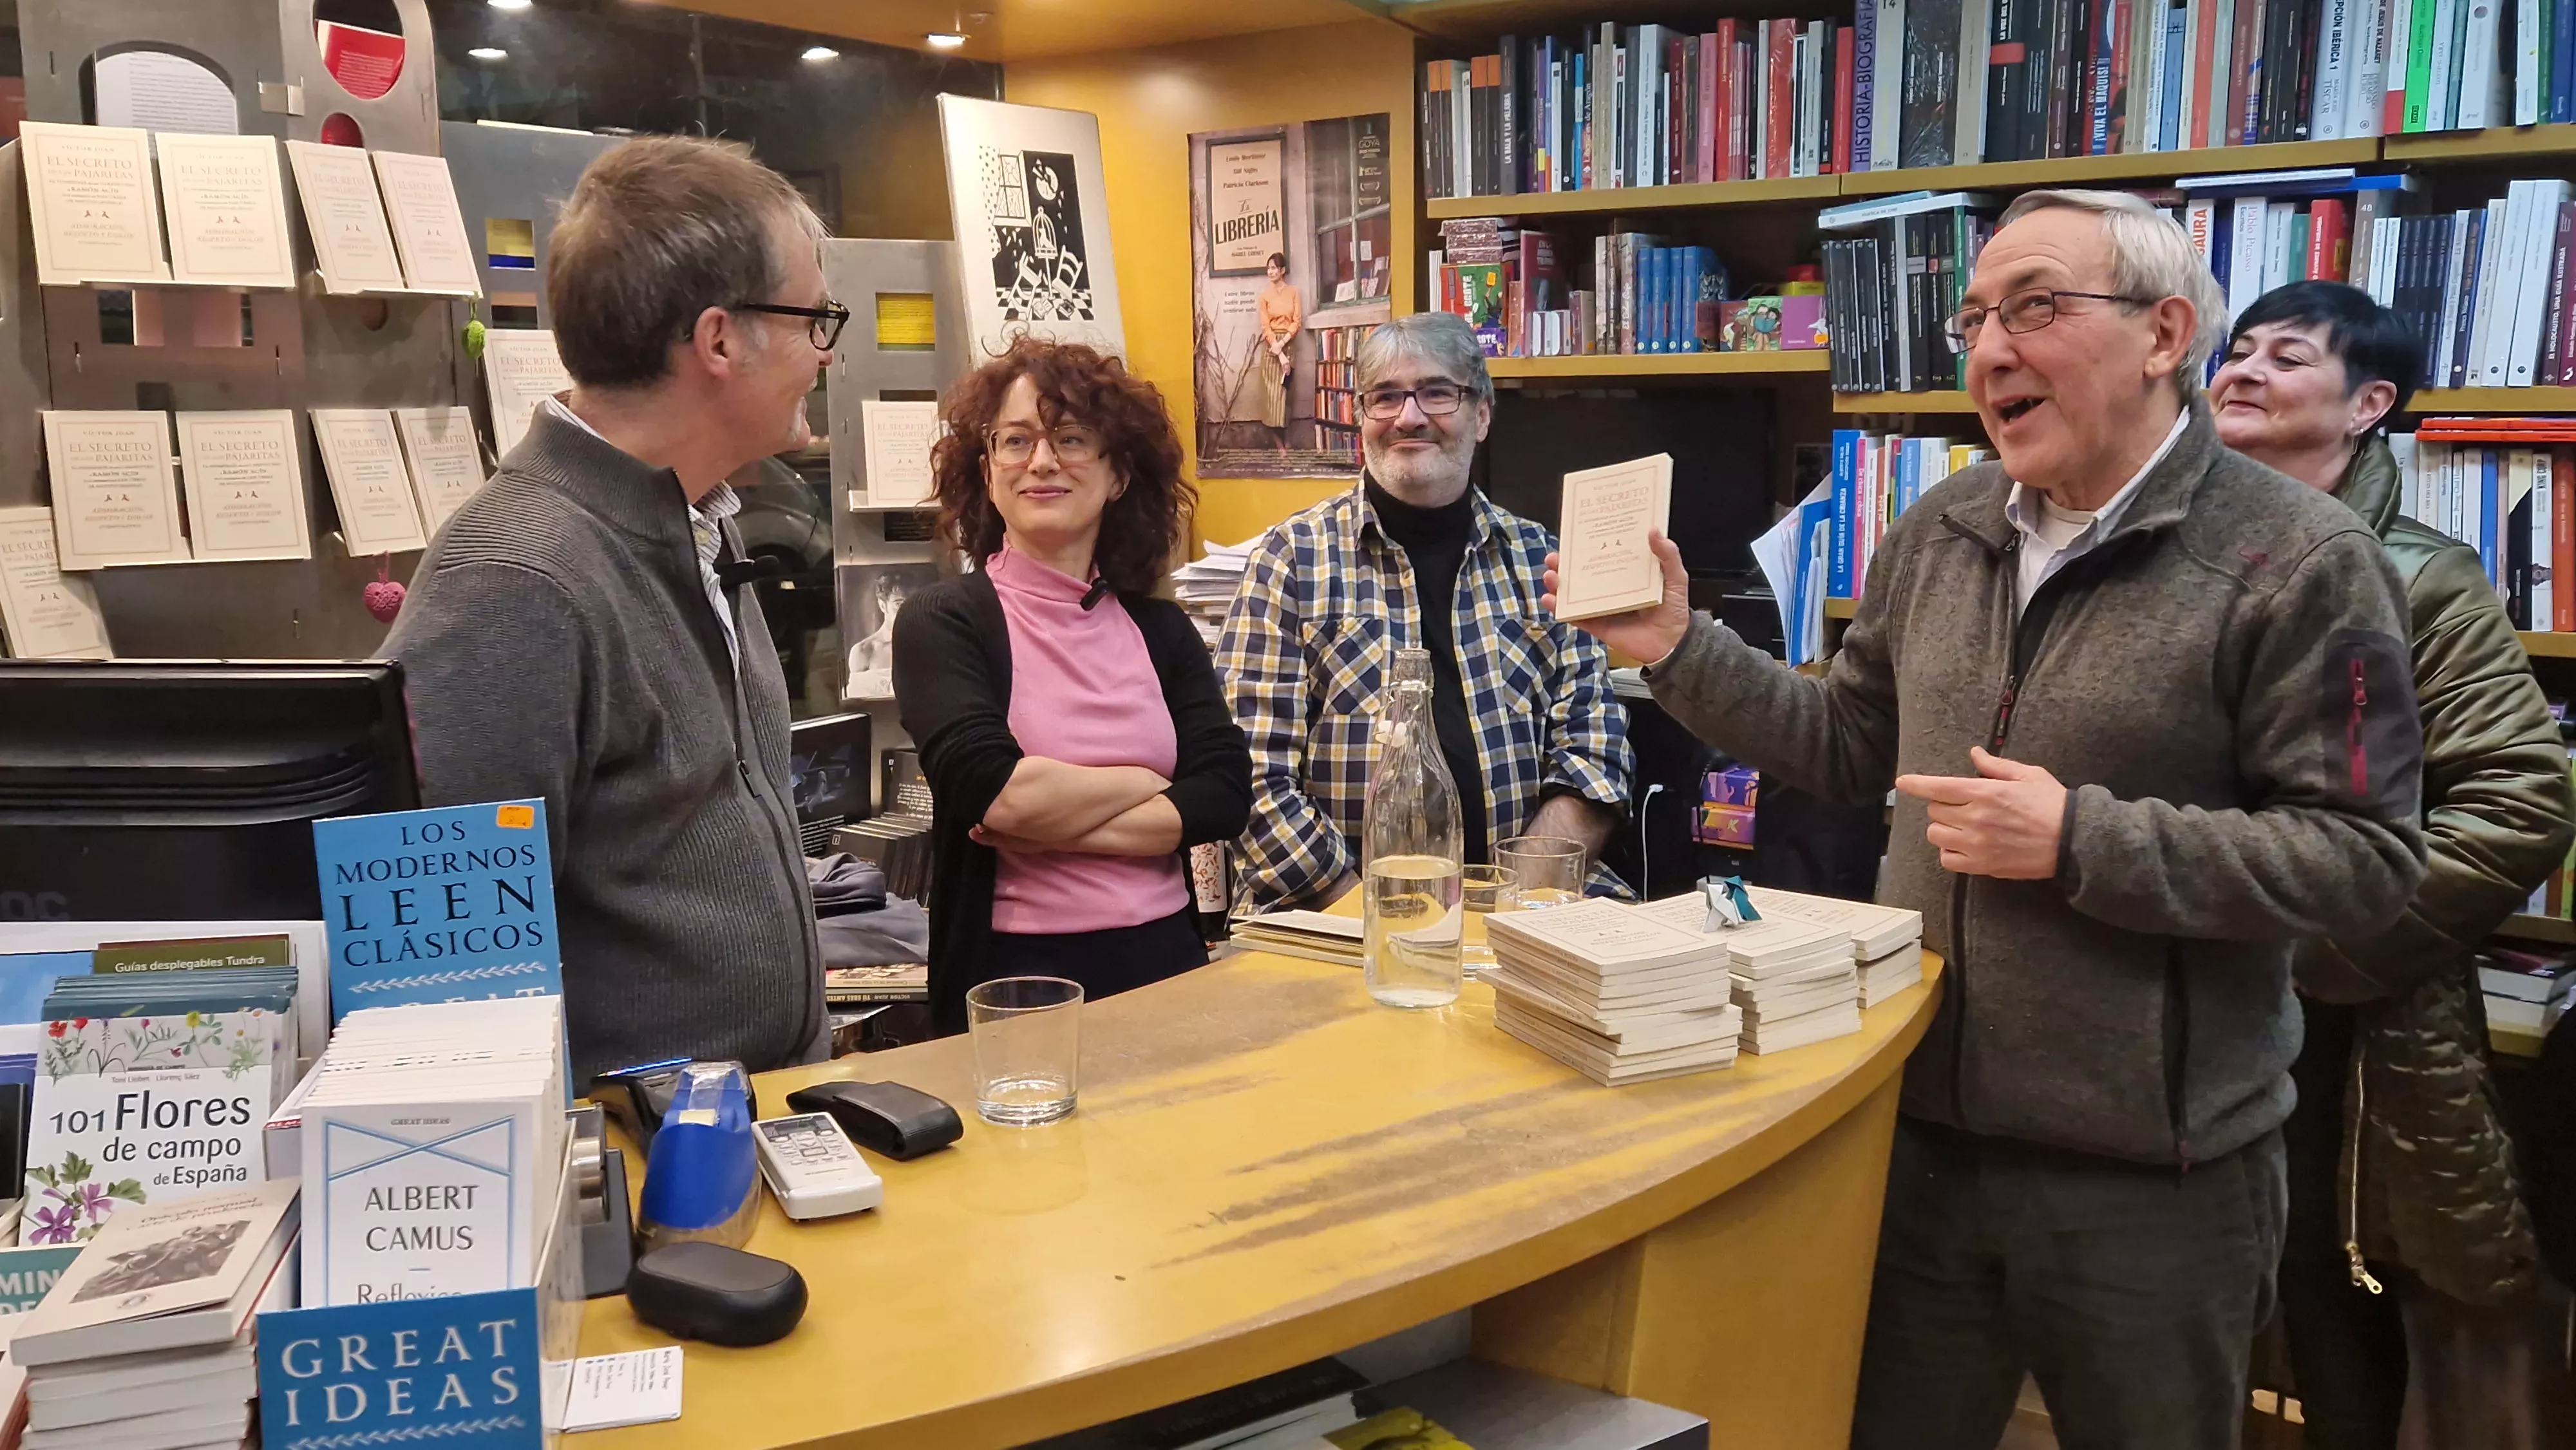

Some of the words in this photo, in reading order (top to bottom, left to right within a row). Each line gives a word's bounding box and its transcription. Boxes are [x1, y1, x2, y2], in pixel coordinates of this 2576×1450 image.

[2333, 0, 2345, 27] PCIÓN
[2000, 31, 2006, 41] LA
[2330, 30, 2344, 63] IBÉRICA
[2374, 37, 2383, 64] NAZARET
[1584, 82, 1593, 110] Aragón
[2096, 66, 2109, 103] MAQUIS!
[1504, 93, 1512, 121] PALABRA
[2321, 79, 2332, 114] TÍSCAR
[2095, 105, 2107, 116] EL
[1504, 122, 1511, 130] LA
[2093, 118, 2107, 141] ¡VIVA
[1359, 138, 1380, 148] GOYA
[48, 156, 63, 165] EL
[68, 157, 131, 169] SECRETO
[201, 166, 261, 175] SECRETO
[1504, 155, 1511, 164] LA
[74, 169, 133, 178] PAJARITAS
[2360, 203, 2373, 212] 48
[1215, 205, 1280, 245] LIBRERÍA
[2246, 207, 2258, 233] Pablo
[2244, 238, 2256, 272] Picasso
[2557, 247, 2567, 278] ILUSTRADA
[2553, 279, 2562, 295] GUÍA
[2553, 296, 2561, 309] UNA
[2549, 312, 2560, 352] HOLOCAUSTO,
[70, 443, 86, 452] EL
[89, 442, 151, 452] SECRETO
[201, 442, 216, 451] EL
[220, 441, 278, 451] SECRETO
[349, 438, 386, 448] SECRETO
[96, 454, 153, 462] PAJARITAS
[225, 452, 280, 461] PAJARITAS
[2536, 475, 2546, 489] KING
[1580, 497, 1593, 508] EL
[1596, 486, 1649, 506] SECRETO
[2, 544, 15, 552] EL
[17, 541, 52, 551] SECRE
[1837, 532, 1846, 547] GUÍA
[1837, 565, 1844, 573] LA
[402, 820, 466, 846] LOS
[336, 844, 535, 886] MODERNOS
[339, 875, 536, 932] LEEN
[344, 921, 543, 966] CLÁSICOS
[115, 962, 147, 973] Guías
[149, 958, 223, 971] desplegables
[225, 956, 265, 966] Tundra
[50, 1108, 105, 1135] 101
[115, 1090, 252, 1131] Flores
[390, 1118, 421, 1126] GREAT
[102, 1136, 137, 1163] de
[147, 1137, 242, 1165] campo
[153, 1172, 170, 1186] de
[173, 1164, 247, 1188] España
[365, 1185, 479, 1211] ALBERT
[365, 1225, 473, 1251] CAMUS
[281, 1318, 516, 1379] GREAT
[285, 1366, 519, 1427] IDEAS
